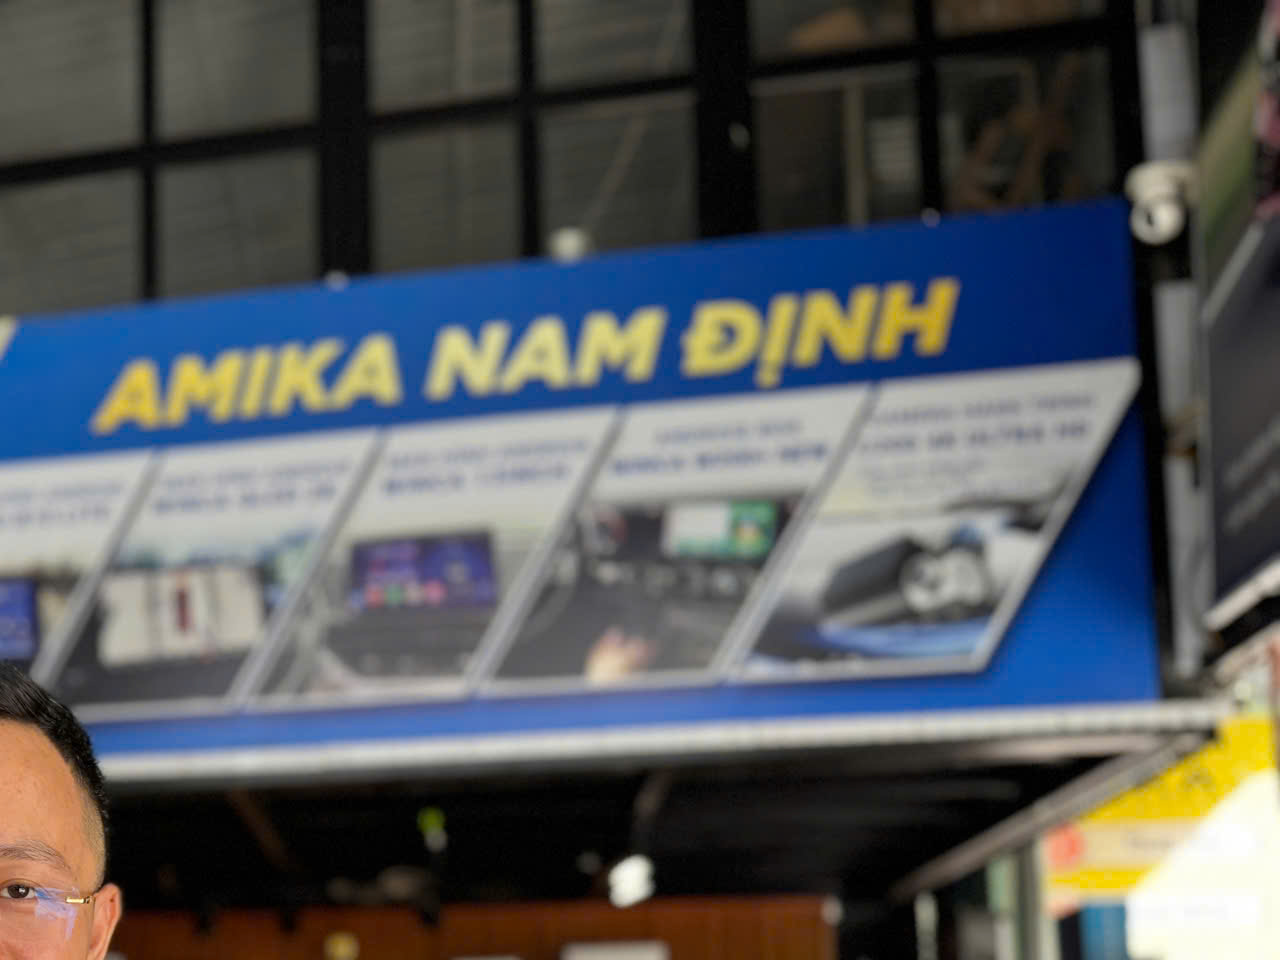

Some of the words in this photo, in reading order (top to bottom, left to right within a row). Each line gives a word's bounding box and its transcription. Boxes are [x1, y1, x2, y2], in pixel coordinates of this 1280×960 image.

[89, 333, 403, 436] AMIKA
[424, 307, 668, 400] NAM
[679, 277, 961, 389] ĐỊNH
